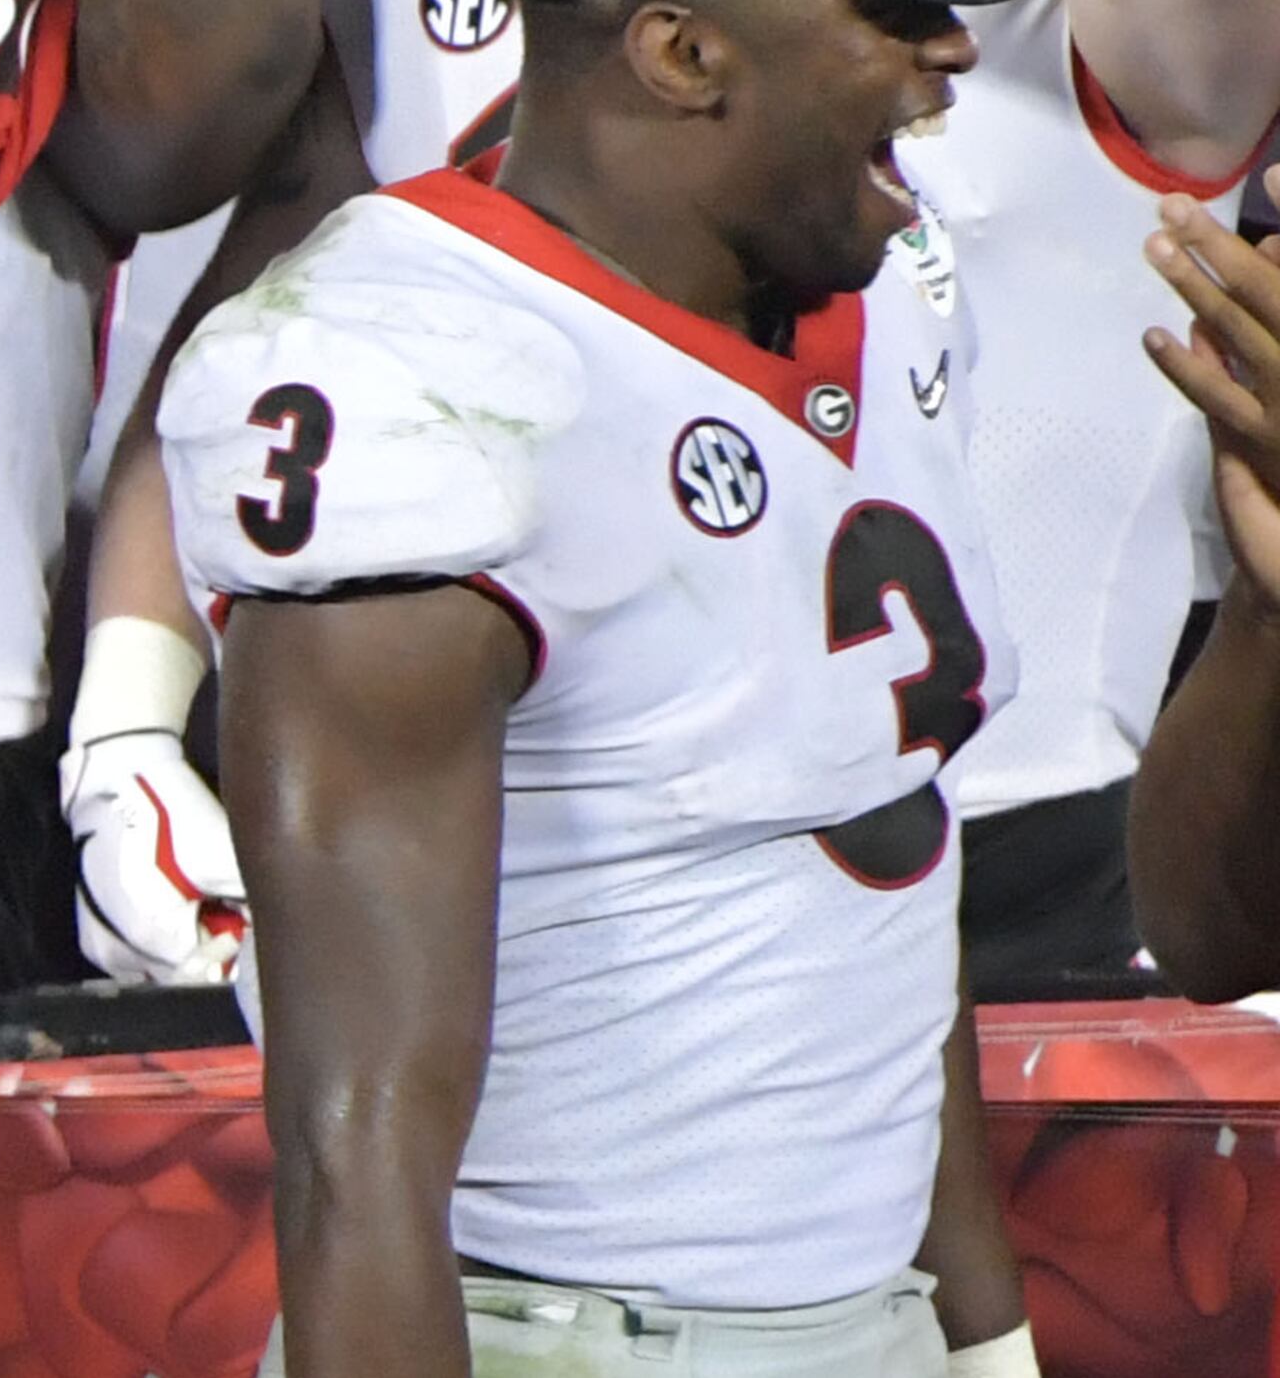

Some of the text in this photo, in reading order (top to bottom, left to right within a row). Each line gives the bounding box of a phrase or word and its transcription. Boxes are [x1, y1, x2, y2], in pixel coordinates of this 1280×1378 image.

[236, 382, 335, 557] 3
[677, 423, 763, 529] SEC
[807, 387, 852, 433] G
[816, 499, 989, 892] 3
